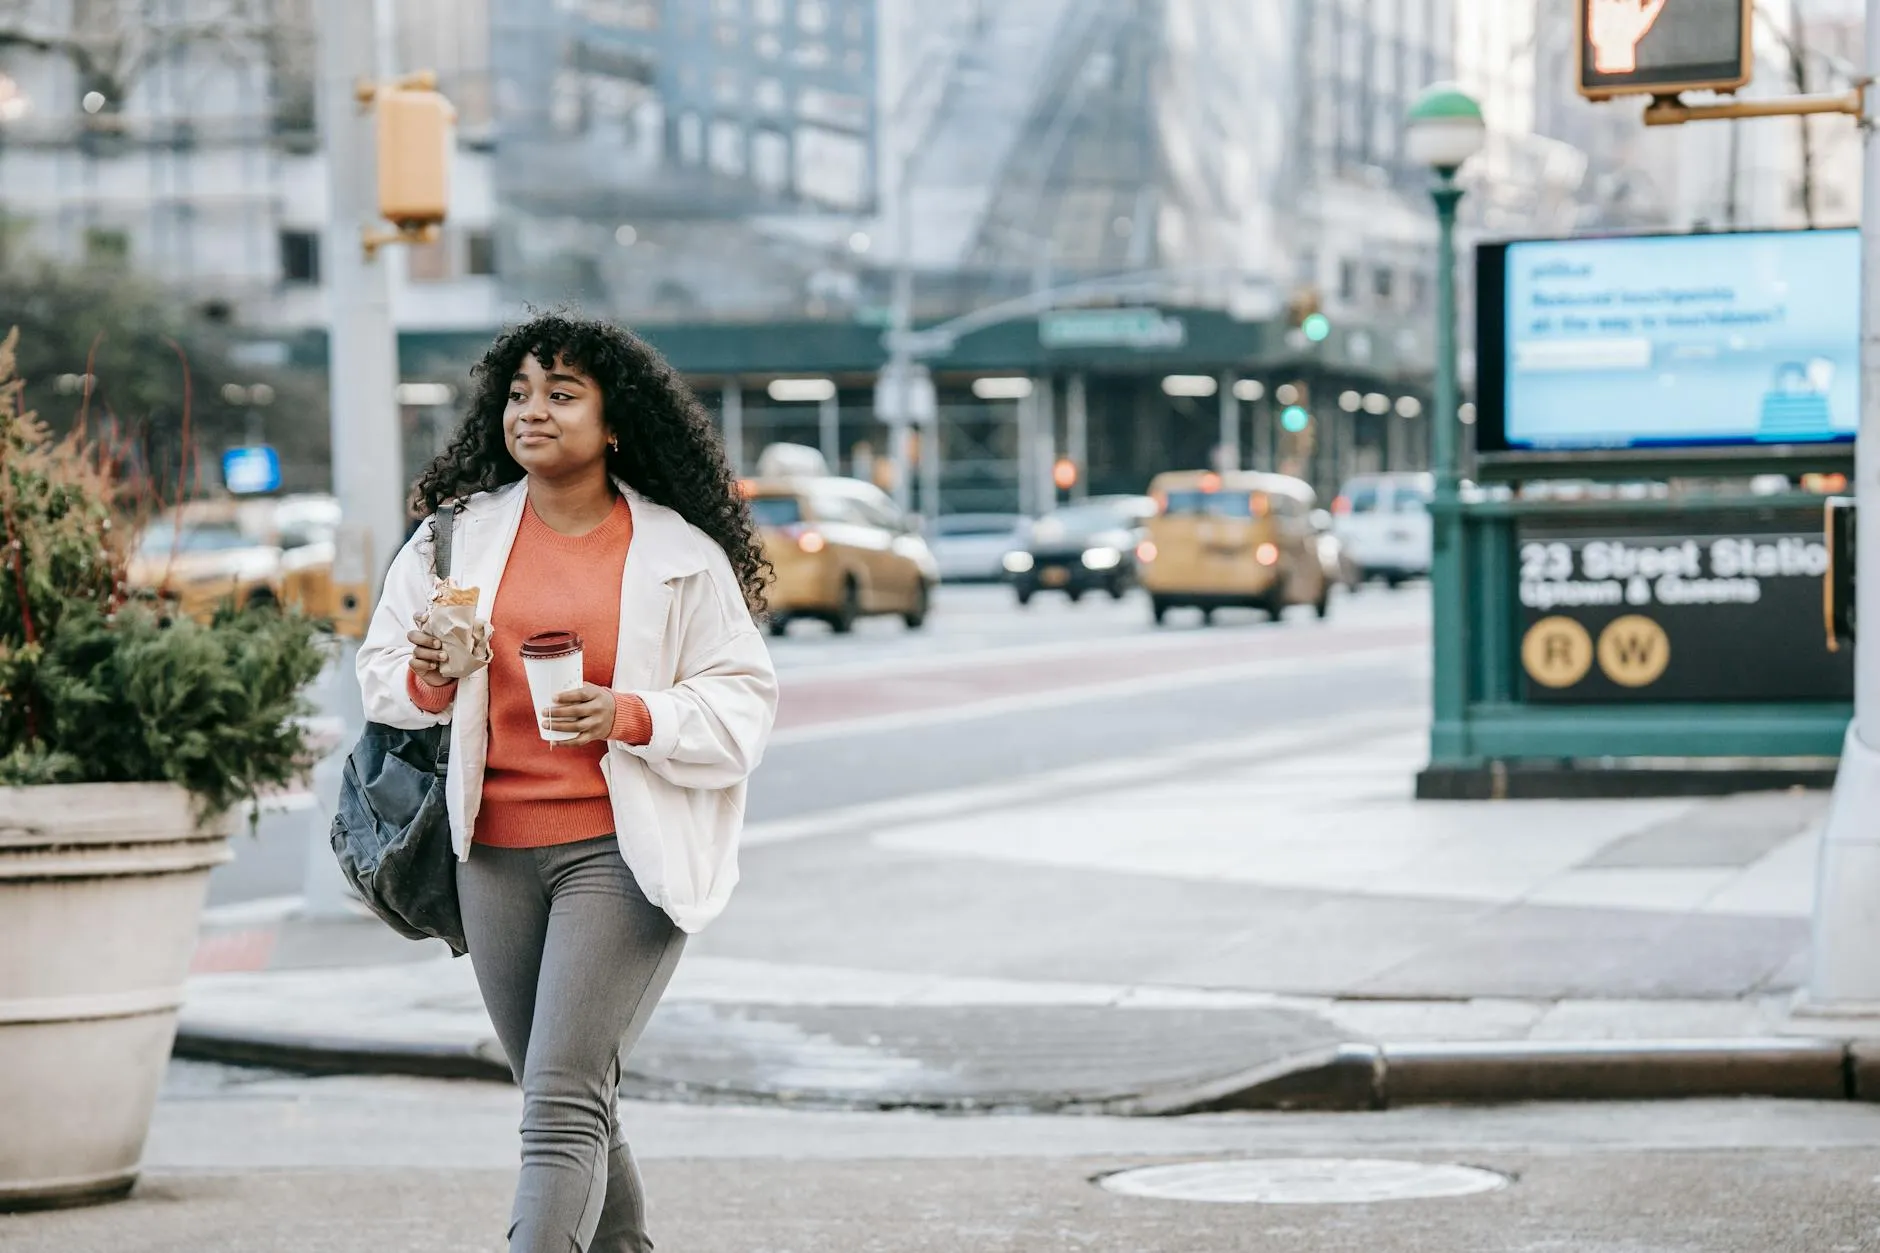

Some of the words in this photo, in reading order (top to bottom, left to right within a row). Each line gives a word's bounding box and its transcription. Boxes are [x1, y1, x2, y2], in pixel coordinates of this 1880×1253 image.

[1521, 542, 1573, 580] 23
[1582, 540, 1700, 579] Street
[1711, 537, 1828, 577] Statio
[1520, 579, 1623, 609] Uptown
[1626, 575, 1650, 605] &
[1655, 575, 1760, 604] Queens
[1543, 633, 1575, 667] R
[1612, 634, 1656, 667] W
